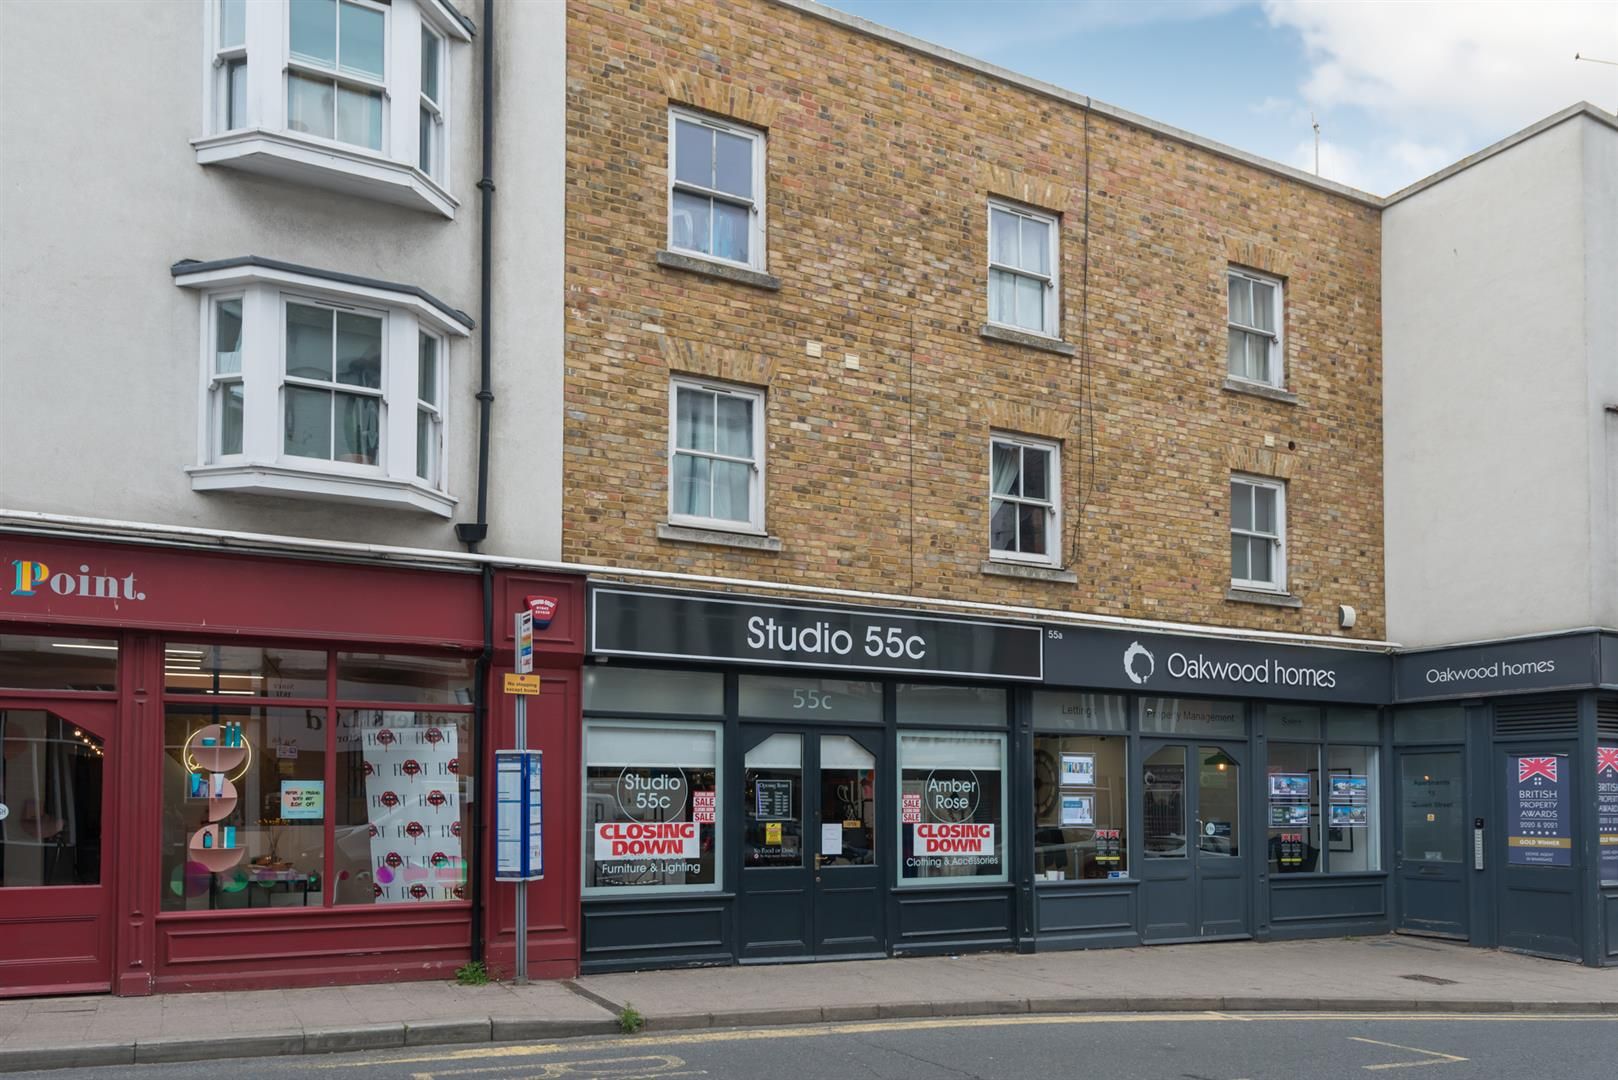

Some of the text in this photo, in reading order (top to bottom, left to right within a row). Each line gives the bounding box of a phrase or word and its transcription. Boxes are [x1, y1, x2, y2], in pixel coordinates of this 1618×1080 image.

[11, 559, 146, 600] Point.
[747, 615, 926, 660] Studio 55c
[1048, 630, 1063, 640] 55a
[1167, 652, 1336, 688] Oakwood homes
[1426, 659, 1555, 684] Oakwood homes
[792, 688, 833, 710] 55c
[1183, 710, 1235, 724] Management
[624, 773, 680, 790] Studio
[928, 778, 976, 793] Amber
[636, 793, 671, 809] 55c
[695, 797, 714, 807] SALE
[935, 794, 969, 809] Rose
[1519, 790, 1558, 799] BRITISH
[903, 800, 920, 808] SALE
[1519, 801, 1558, 809] PROPERTY
[695, 812, 714, 821] SALE
[903, 813, 920, 822] SALE
[1519, 810, 1558, 818] AWARDS
[600, 823, 695, 840] CLOSING
[917, 824, 991, 839] CLOSING
[612, 840, 683, 856] DOWN
[926, 838, 982, 853] DOWN
[602, 863, 701, 875] Furniture & Lighting
[906, 855, 999, 868] Clothing & Accessories
